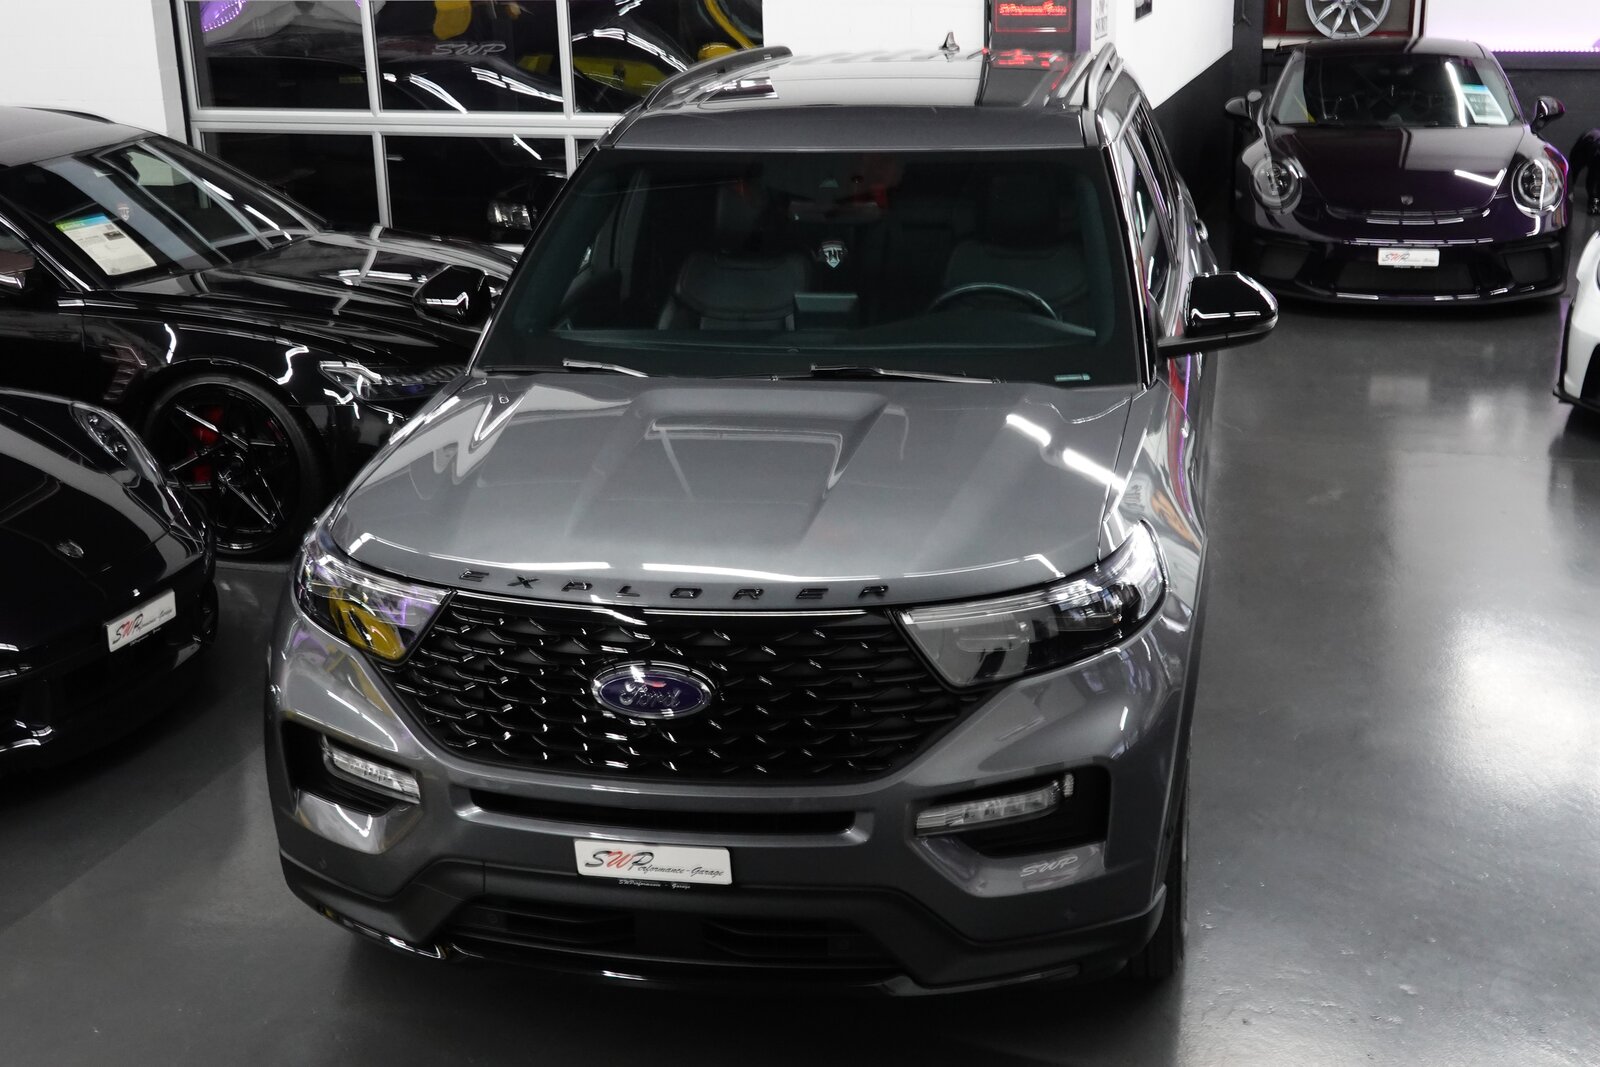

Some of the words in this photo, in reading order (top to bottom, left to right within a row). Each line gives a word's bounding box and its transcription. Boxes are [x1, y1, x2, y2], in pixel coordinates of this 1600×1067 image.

[431, 43, 507, 56] SWP
[459, 568, 889, 600] EXPLORER
[618, 680, 681, 706] Ford
[1020, 855, 1079, 877] SWP
